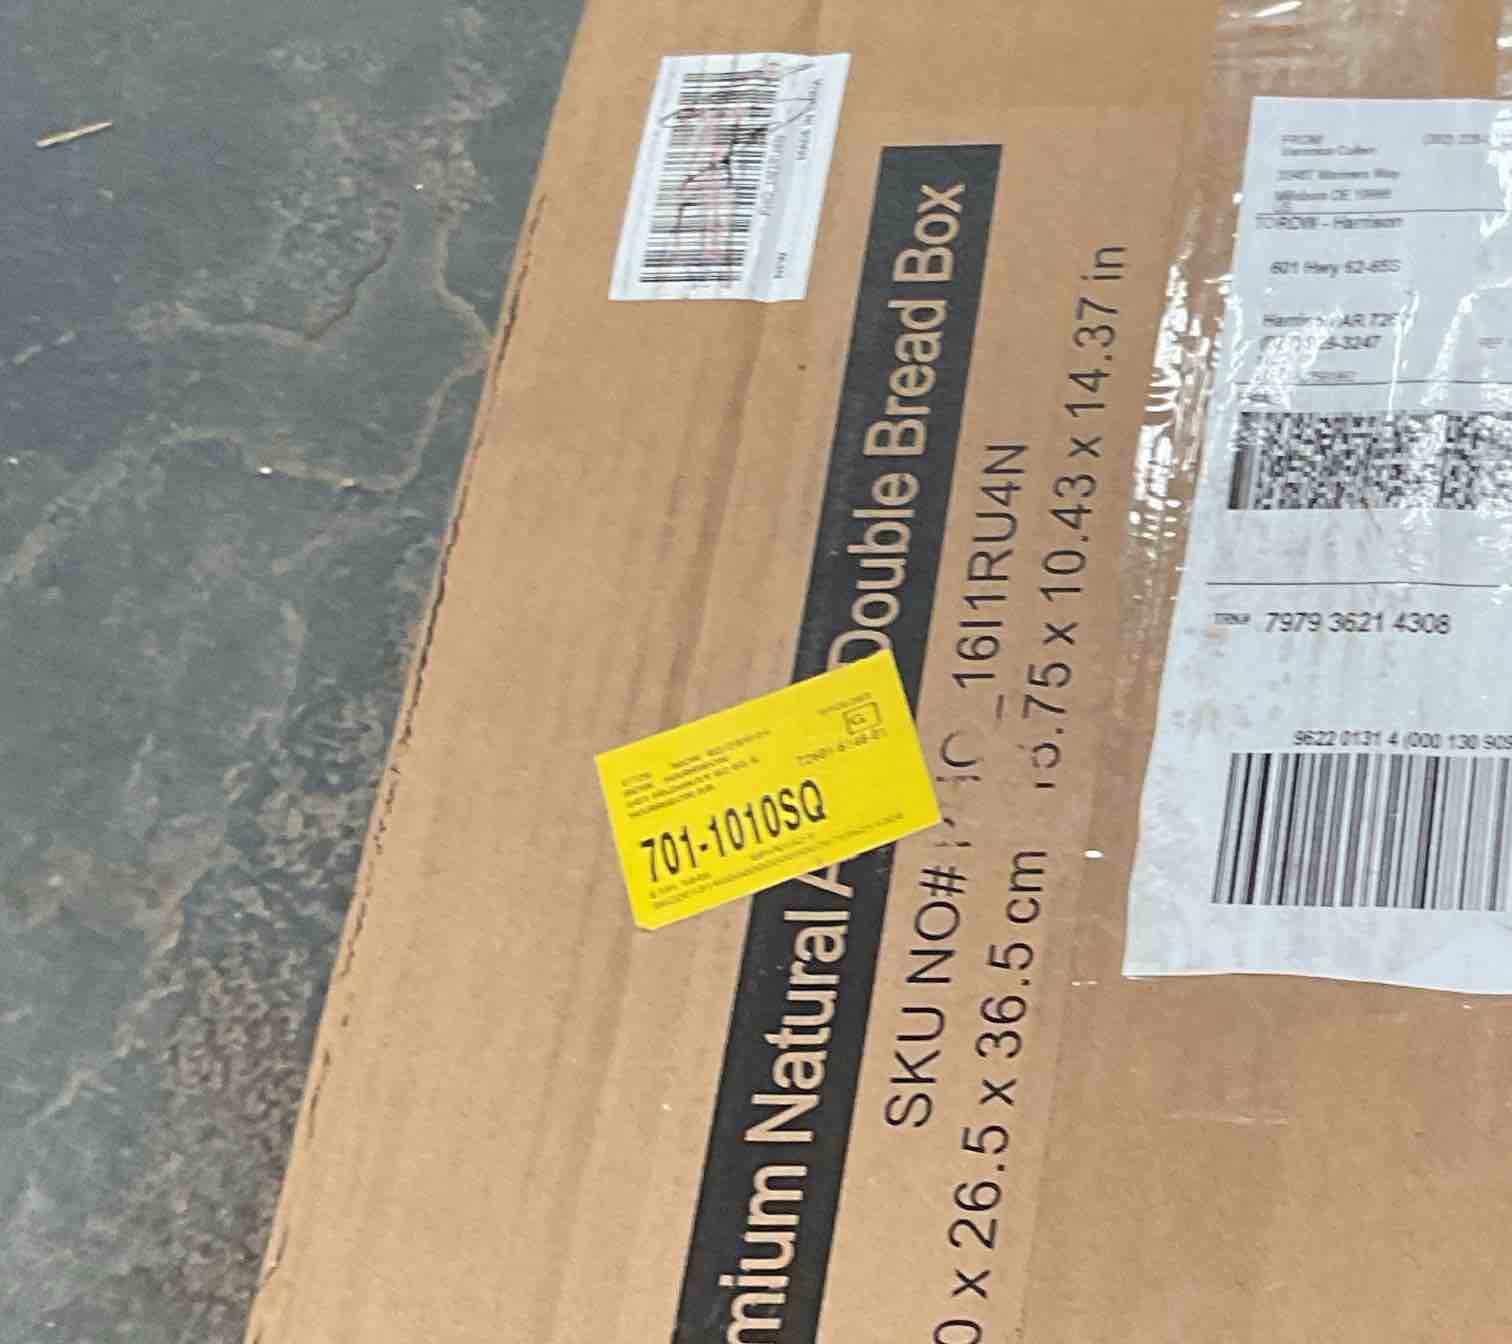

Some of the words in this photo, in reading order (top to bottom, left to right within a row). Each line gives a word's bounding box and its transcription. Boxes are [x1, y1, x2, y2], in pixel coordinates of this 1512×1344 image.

[893, 182, 966, 284] Box
[1081, 245, 1128, 281] in
[863, 299, 947, 457] Bread
[1065, 296, 1121, 417] 14.37
[1068, 435, 1103, 459] x
[827, 471, 920, 673] Double
[1041, 473, 1097, 601] 10.43
[1042, 621, 1078, 647] x
[1266, 612, 1321, 632] 7979
[1328, 612, 1384, 633] 3621
[1394, 612, 1452, 635] 4308
[1293, 730, 1337, 747] 9622
[1340, 730, 1383, 746] 0131
[1387, 730, 1399, 746] 4
[640, 779, 826, 883] 701-1010SQ
[906, 864, 967, 984] NO#
[1005, 849, 1047, 925] cm
[744, 909, 851, 1144] Natural
[974, 941, 1034, 1060] 36.5
[885, 1006, 944, 1128] SKU
[977, 1078, 1017, 1107] x
[948, 1124, 1011, 1250] 26.5
[952, 1267, 991, 1299] x
